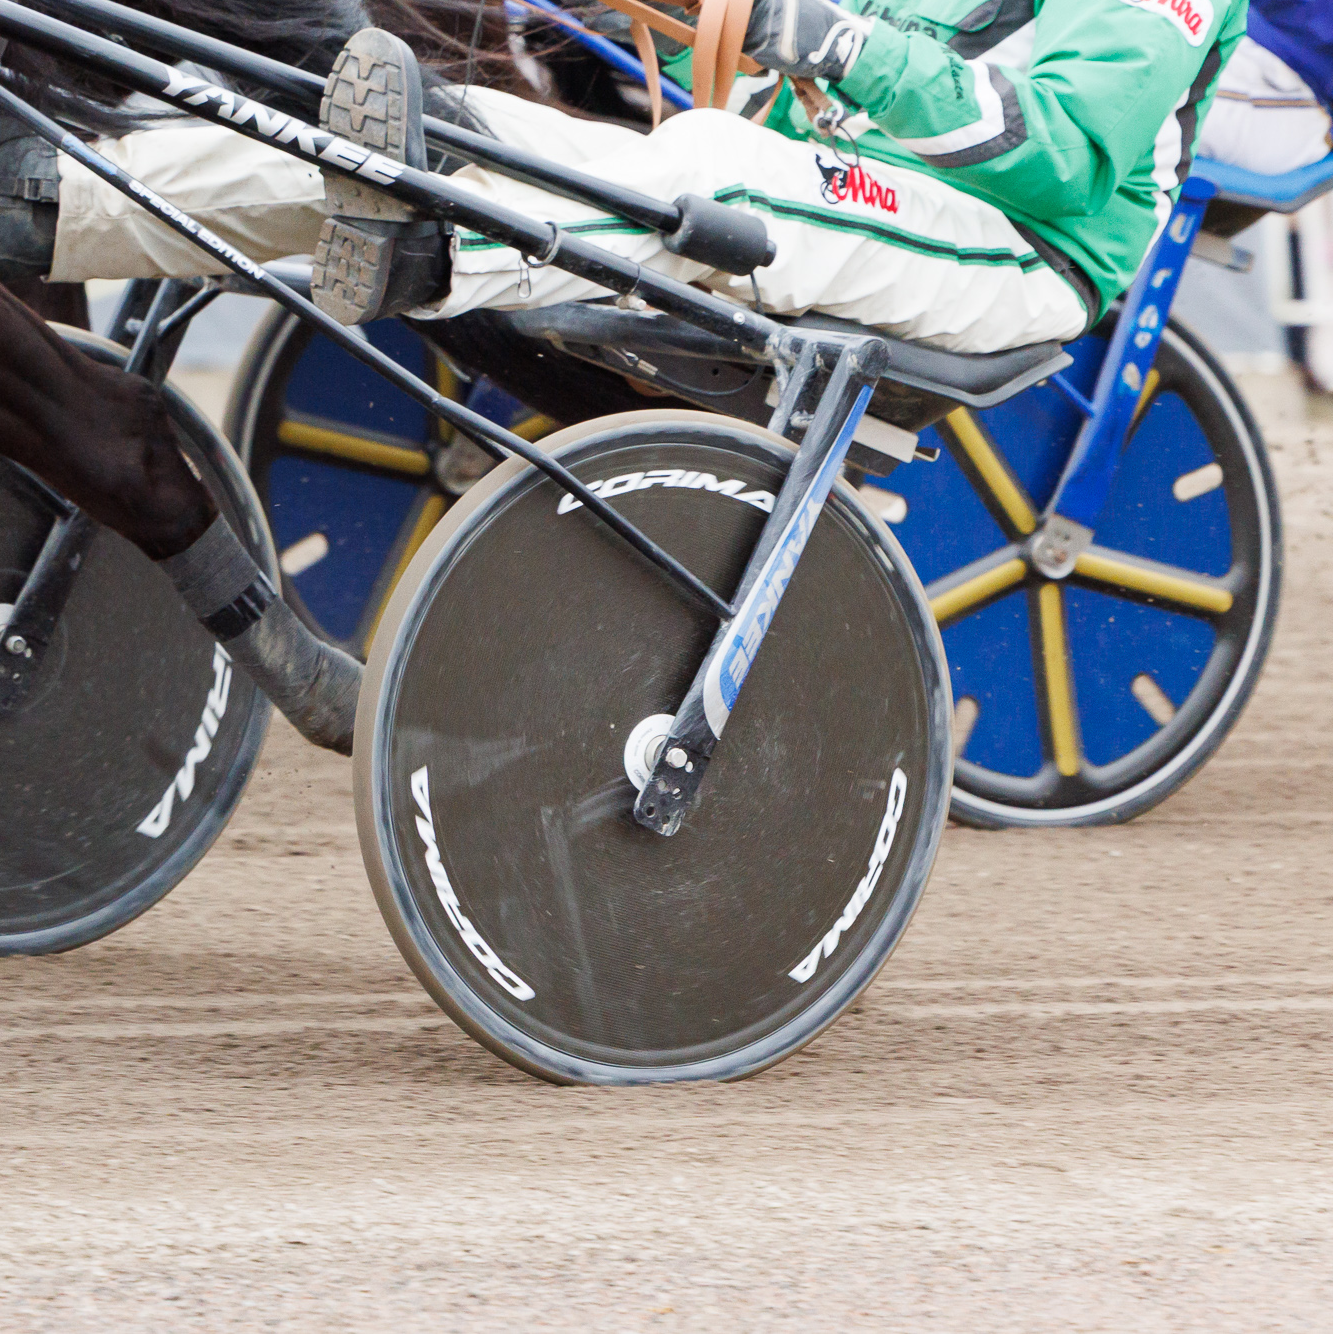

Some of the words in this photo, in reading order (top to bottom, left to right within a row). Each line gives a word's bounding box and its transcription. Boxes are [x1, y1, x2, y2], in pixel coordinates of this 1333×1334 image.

[162, 65, 408, 186] YANKEE
[128, 178, 200, 235] SPECIAL
[196, 226, 267, 281] EDITION
[832, 163, 900, 214] Mira
[556, 469, 776, 515] CORIMA
[135, 641, 233, 839] RIMA
[410, 765, 536, 1003] CORIMA
[788, 767, 908, 984] CORIMA
